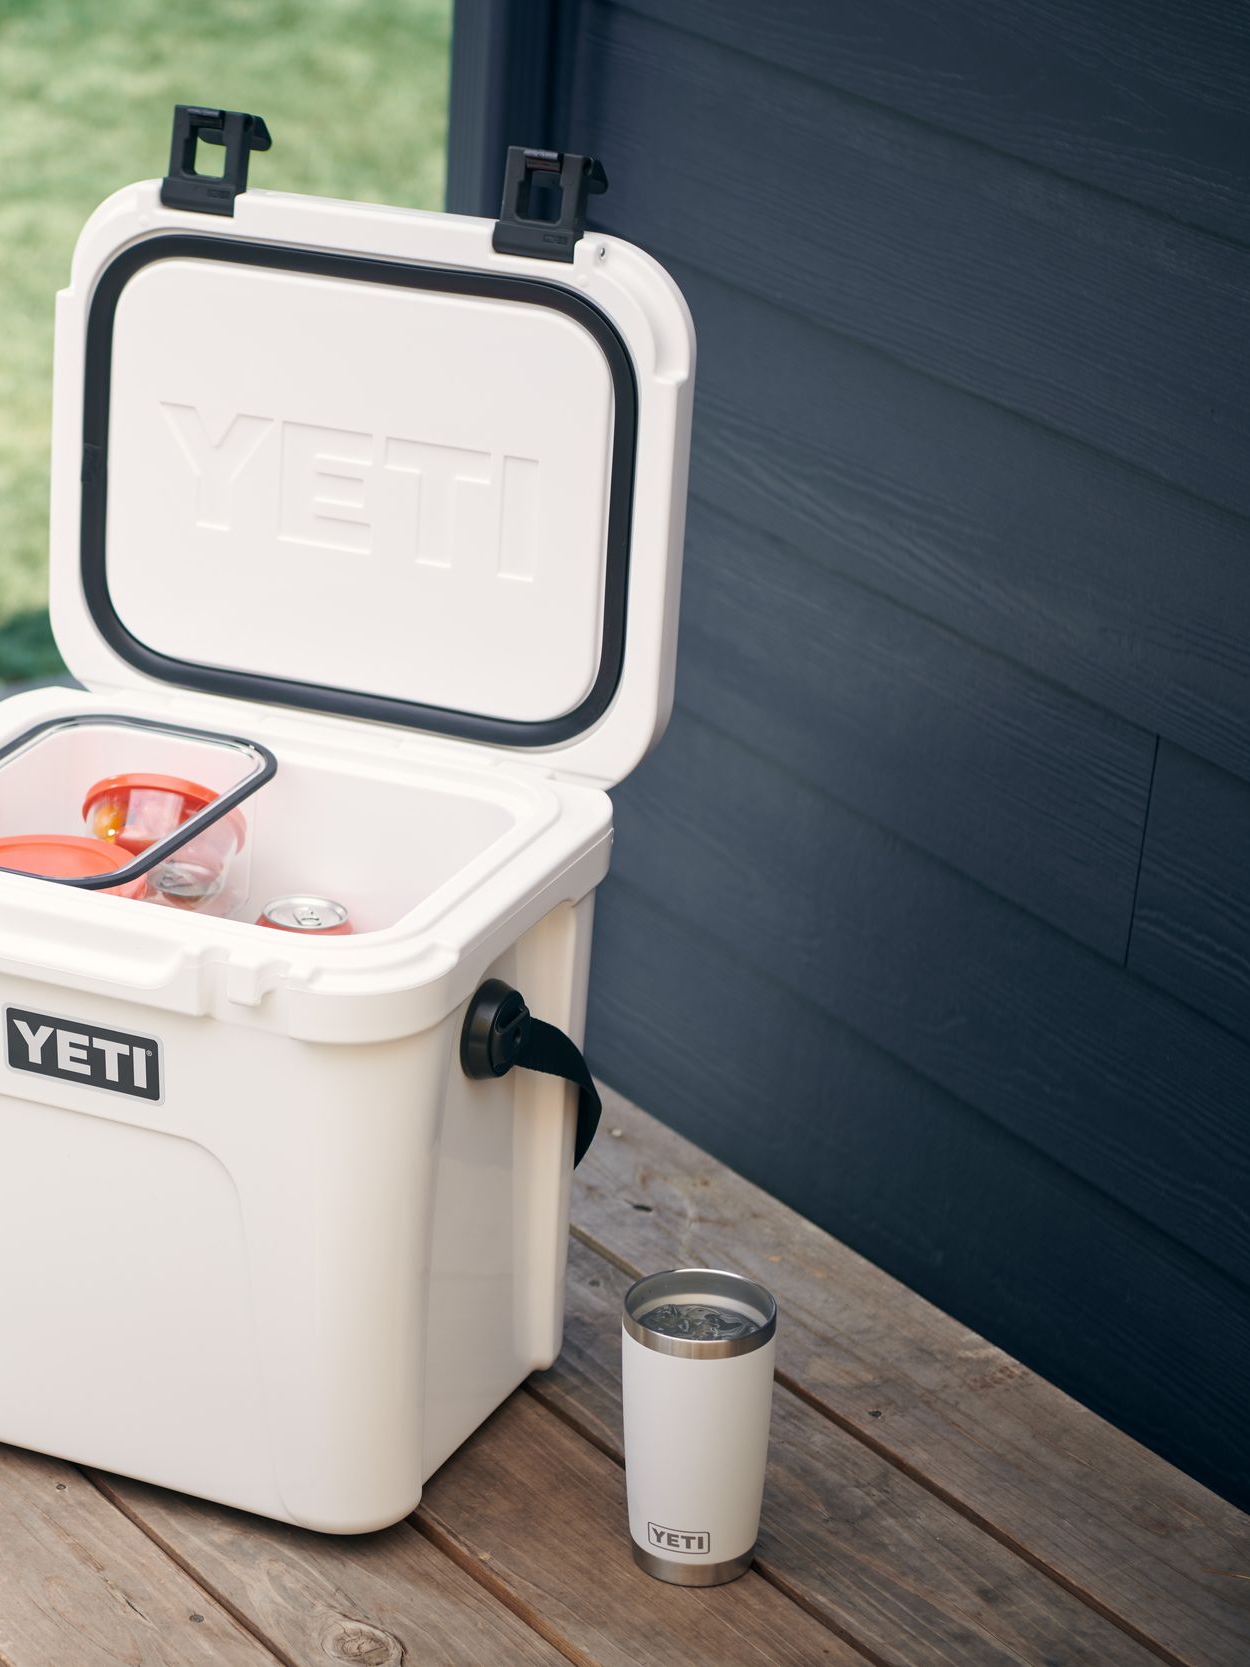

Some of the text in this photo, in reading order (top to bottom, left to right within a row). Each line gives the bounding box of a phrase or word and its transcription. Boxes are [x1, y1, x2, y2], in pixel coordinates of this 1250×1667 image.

[159, 401, 540, 582] YETI
[12, 1018, 148, 1089] YETI
[652, 1527, 704, 1550] YETI
